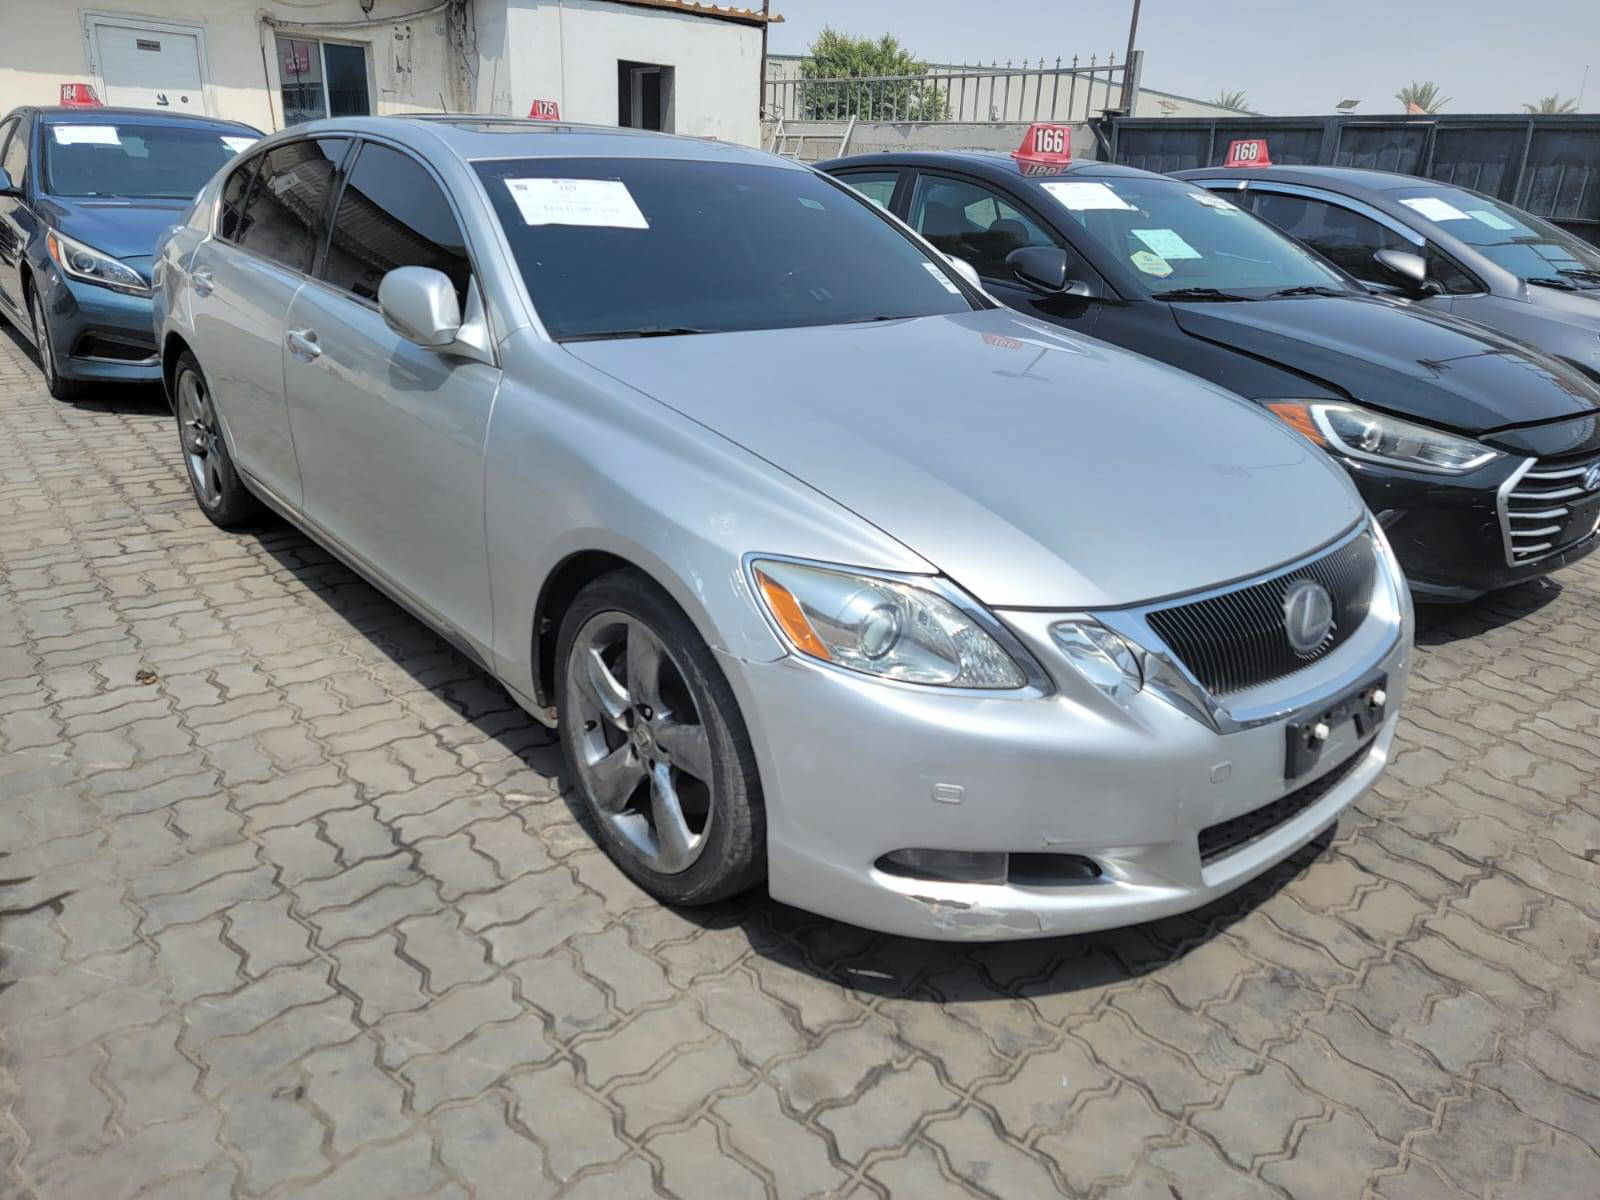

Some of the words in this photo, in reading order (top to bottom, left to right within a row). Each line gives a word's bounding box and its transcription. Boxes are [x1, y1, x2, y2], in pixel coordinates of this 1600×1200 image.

[538, 101, 554, 115] 175
[1037, 128, 1064, 152] 166
[1234, 142, 1258, 160] 168
